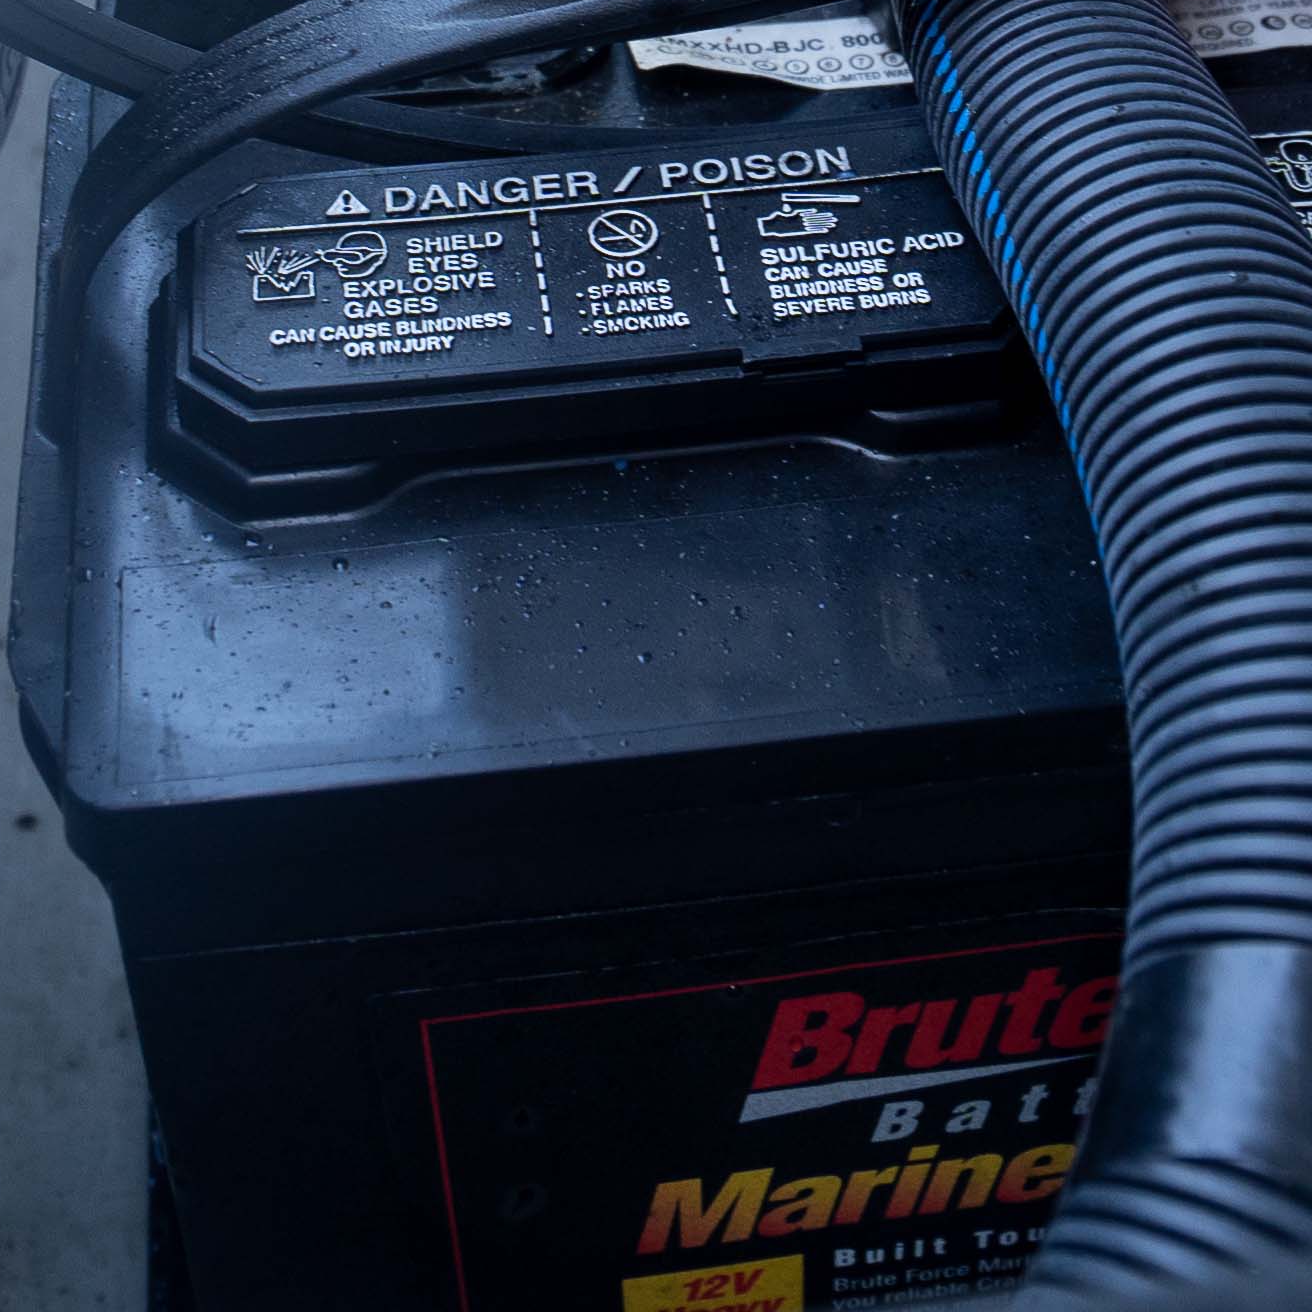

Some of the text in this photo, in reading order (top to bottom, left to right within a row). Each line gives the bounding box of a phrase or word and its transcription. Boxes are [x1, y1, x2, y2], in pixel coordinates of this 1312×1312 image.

[383, 170, 600, 214] DANGER
[659, 145, 854, 189] POISON
[406, 231, 503, 254] SHIELD
[760, 231, 964, 265] SULFURIC ACID
[408, 252, 479, 275] EYES
[605, 260, 646, 279] NO
[765, 259, 888, 282] CAN CAUSE
[343, 271, 496, 299] EXPLOSIVE
[769, 272, 924, 300] BLINDNESS OR
[343, 296, 439, 320] GASES
[591, 295, 674, 316] FLAMES
[774, 289, 931, 318] SEVERE BURNS
[269, 311, 513, 346] CAN CAUSE BLINDNESS
[343, 336, 455, 358] OR INJURY
[833, 1237, 948, 1268] Built
[682, 1266, 766, 1304] 12V
[832, 1273, 898, 1293] Brute
[905, 1264, 970, 1283] Force
